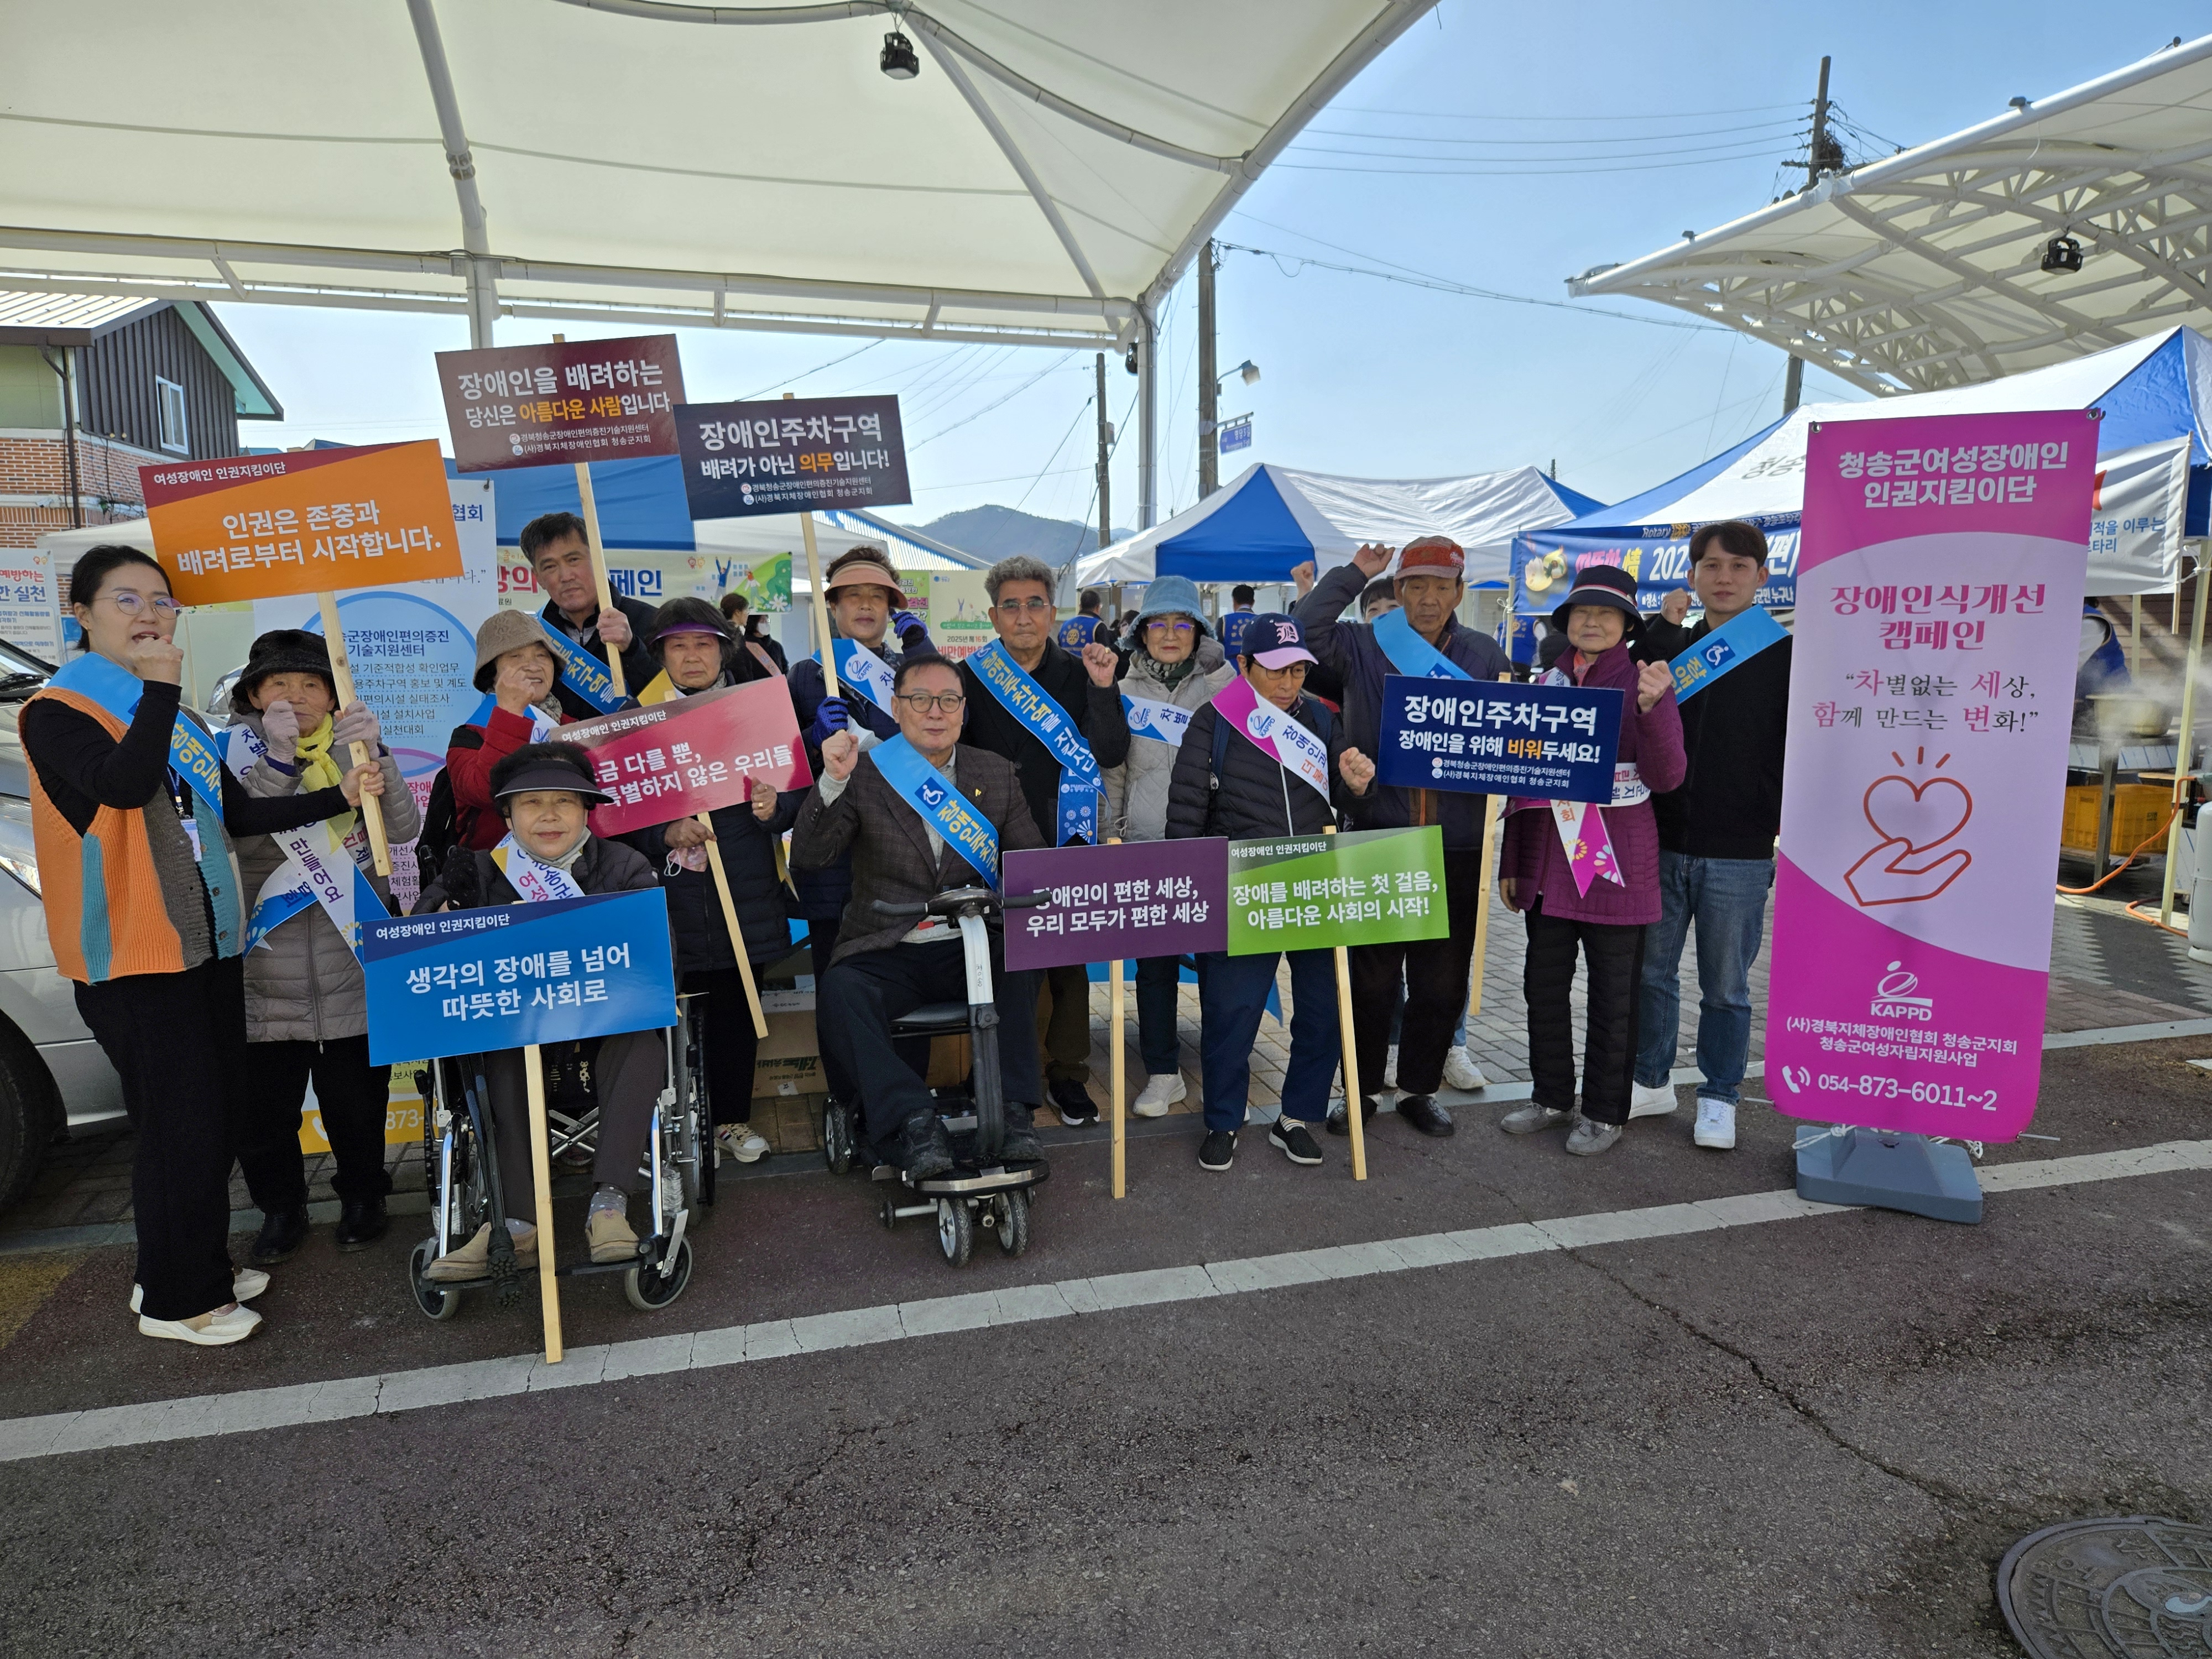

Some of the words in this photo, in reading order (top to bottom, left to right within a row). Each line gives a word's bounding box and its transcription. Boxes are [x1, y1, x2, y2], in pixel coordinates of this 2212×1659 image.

[458, 367, 557, 401] 장애인을
[565, 359, 663, 391] 배려하는
[466, 404, 516, 429] 당신은
[519, 399, 586, 424] 아름다운
[521, 424, 649, 443] 경북청송군장애인편의증진기술지원센터
[524, 437, 608, 455] (사)경북지체장애인협회
[611, 435, 651, 447] 청송군지회
[699, 412, 882, 451] 장애인주차구역
[154, 467, 213, 487] 여성장애인
[216, 461, 286, 481] 인권지킴이단
[701, 456, 757, 479] 배려가
[759, 453, 796, 476] 아닌
[799, 448, 890, 473] 의무입니다!
[1838, 441, 2068, 479] 청송군여성장애인
[755, 489, 834, 504] (사)경북지체장애인협회
[836, 487, 873, 498] 청송군지회
[1864, 476, 2037, 508] 인권지킴이단
[222, 507, 299, 540] 인권은
[306, 499, 379, 531] 존중과
[1642, 527, 1671, 538] Rotary
[178, 539, 304, 576] 배려로부터
[313, 525, 441, 562] 시작합니다.
[14, 585, 47, 603] 실천
[1772, 586, 1794, 604] 누구나
[1829, 583, 2046, 615] 장애인식개선
[348, 644, 425, 657] 기술지원센터
[1879, 620, 1985, 651] 캠페인
[363, 663, 415, 674] 기준적합성
[419, 662, 460, 674] 확인업무
[410, 679, 431, 689] 홍보
[434, 678, 444, 689] 및
[446, 677, 467, 688] 계도
[409, 693, 450, 705] 실태조사
[981, 651, 1062, 733] 장애인주차구역을
[1846, 669, 1958, 698] “차별없는
[1970, 670, 2036, 700] 세상,
[394, 708, 435, 719] 설치사업
[561, 723, 609, 743] 여성장애인
[611, 709, 667, 733] 인권지킴이단
[1404, 695, 1597, 737] 장애인주차구역
[1812, 701, 1862, 729] 함께
[1876, 708, 1948, 731] 만드는
[1963, 705, 2039, 733] 변화!”
[378, 724, 424, 735] 실천대회
[1399, 729, 1465, 755] 장애인을
[1469, 735, 1504, 758] 위해
[1507, 738, 1601, 764] 비워두세요!
[594, 760, 619, 783] 금
[624, 748, 666, 775] 다를
[671, 742, 701, 765] 뿐,
[687, 761, 728, 789] 않은
[735, 744, 793, 778] 우리들
[1443, 769, 1526, 785] (사)경북지체장애인협회
[1528, 775, 1569, 789] 청송군지회
[1231, 846, 1273, 858] 여성장애인
[1276, 841, 1327, 855] 인권지킴이단
[1114, 879, 1151, 903] 편한
[1155, 876, 1199, 900] 세상,
[1233, 881, 1288, 906] 장애를
[1293, 877, 1366, 901] 배려하는
[1371, 873, 1390, 895] 첫
[1395, 870, 1438, 894] 걸음,
[376, 921, 436, 940] 여성장애인
[439, 914, 510, 933] 인권지킴이단
[1026, 912, 1063, 937] 우리
[1070, 907, 1126, 932] 모두가
[1131, 904, 1168, 927] 편한
[1172, 901, 1209, 924] 세상
[1248, 905, 1322, 930] 아름다운
[1327, 900, 1381, 924] 사회의
[1386, 896, 1430, 919] 시작!
[406, 960, 484, 995] 생각의
[494, 951, 572, 984] 장애를
[581, 942, 631, 974] 넘어
[442, 989, 520, 1022] 따뜻한
[531, 978, 608, 1010] 사회로
[1870, 1003, 1933, 1021] KAPPD
[1786, 1016, 1938, 1046] (사)경북지체장애인협회
[1942, 1032, 2017, 1055] 청송군지회
[1819, 1036, 1978, 1068] 청송군여성자립지원사업
[1817, 1073, 1997, 1112] 054-873-6011~2
